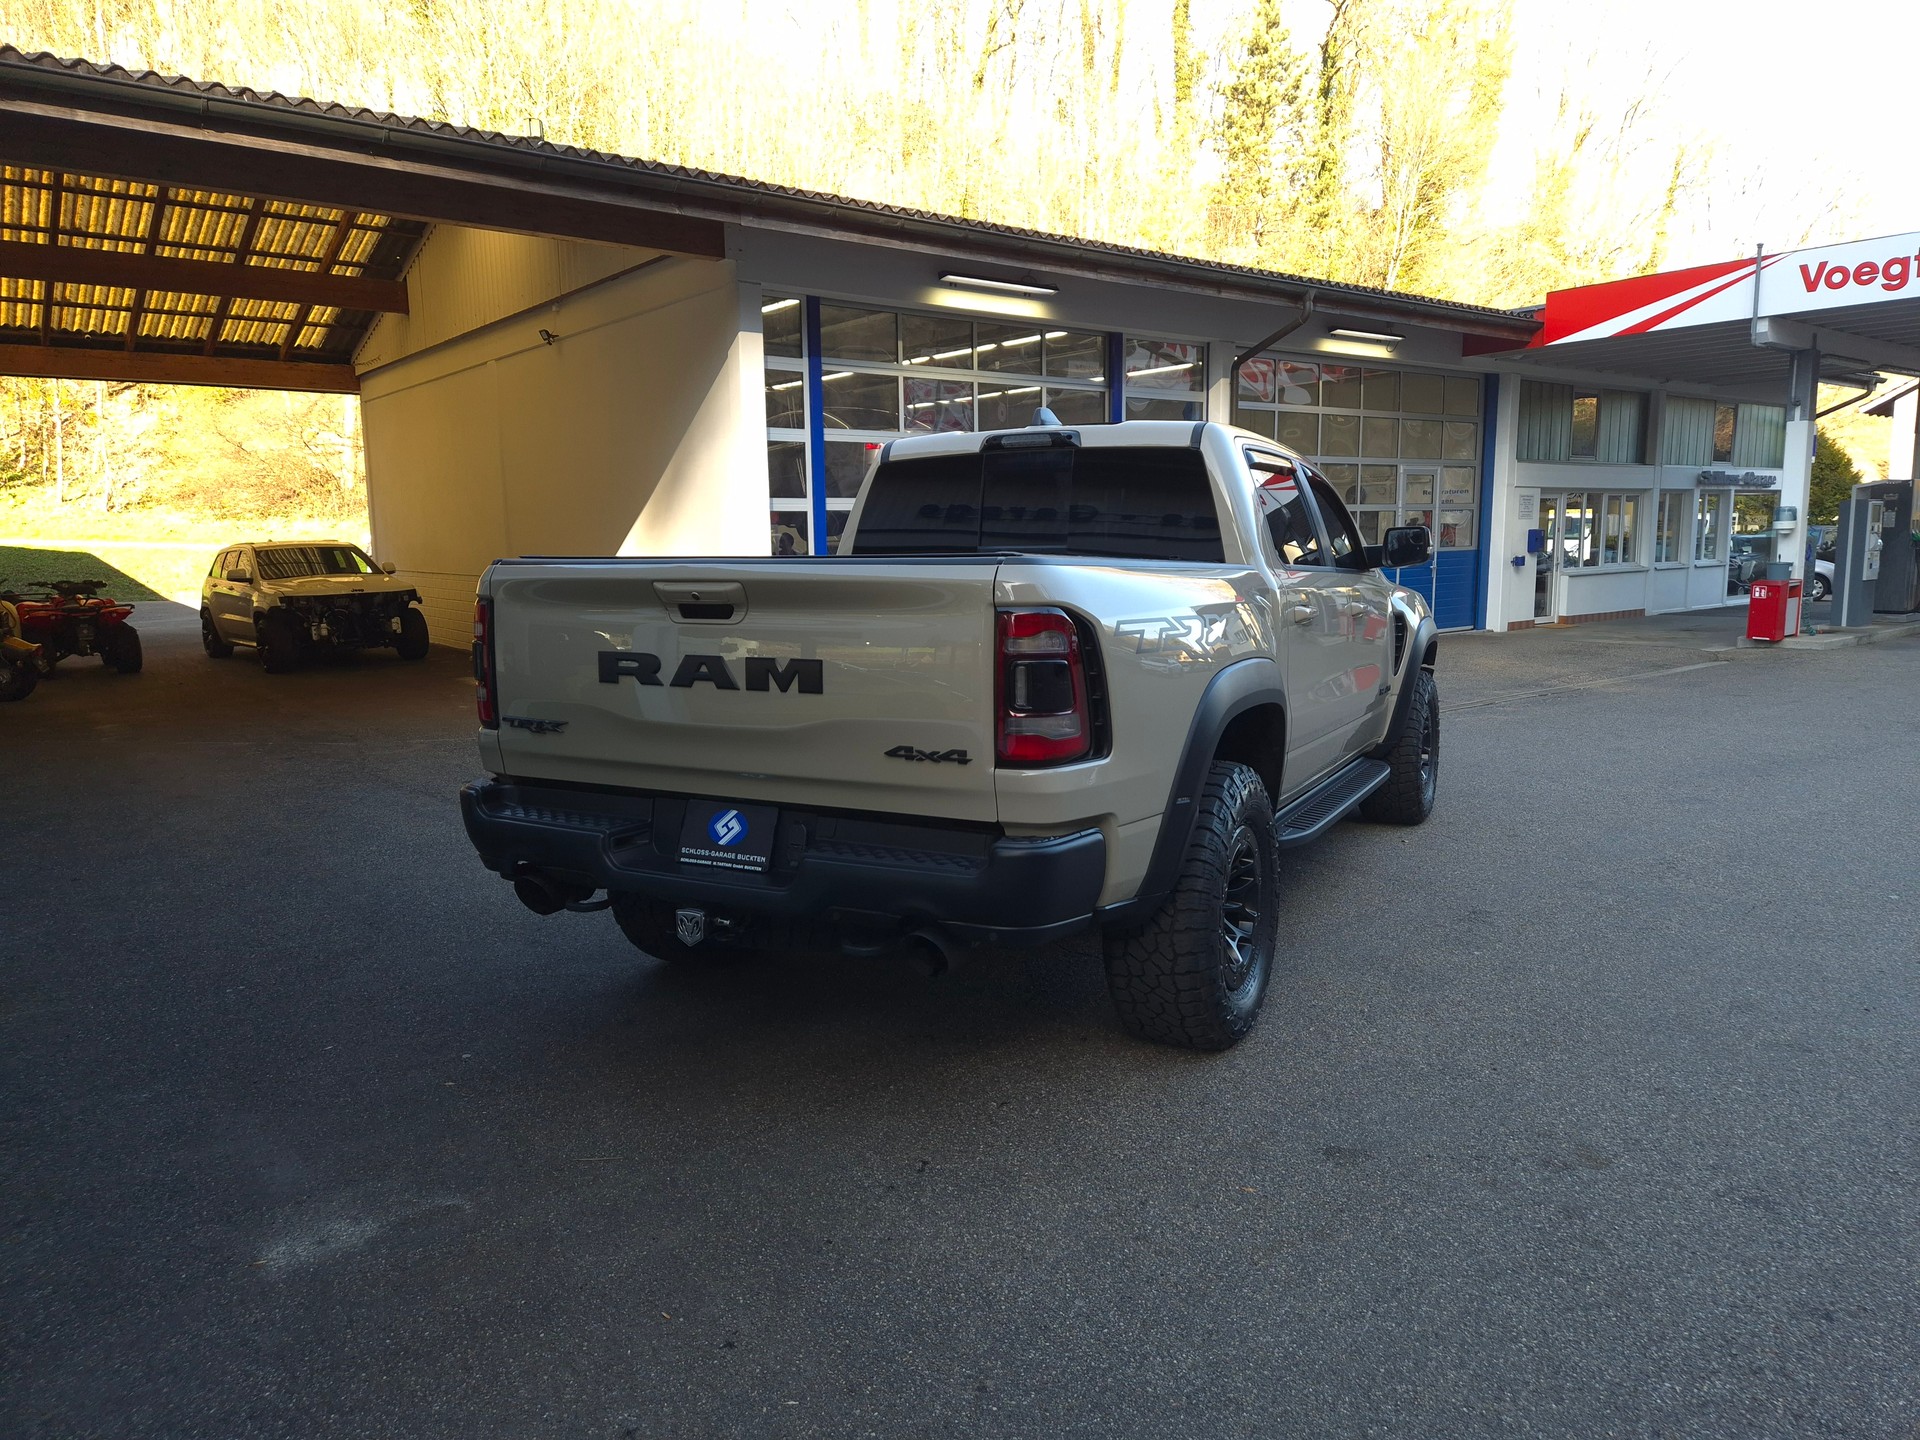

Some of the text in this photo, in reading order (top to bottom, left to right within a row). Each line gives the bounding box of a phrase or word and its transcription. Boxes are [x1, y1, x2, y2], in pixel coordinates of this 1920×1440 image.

[1114, 610, 1249, 660] TRX
[598, 651, 823, 694] RAM
[884, 745, 973, 765] 4x4
[681, 847, 766, 863] SCHLOSS-GARAGE BUCKTEN
